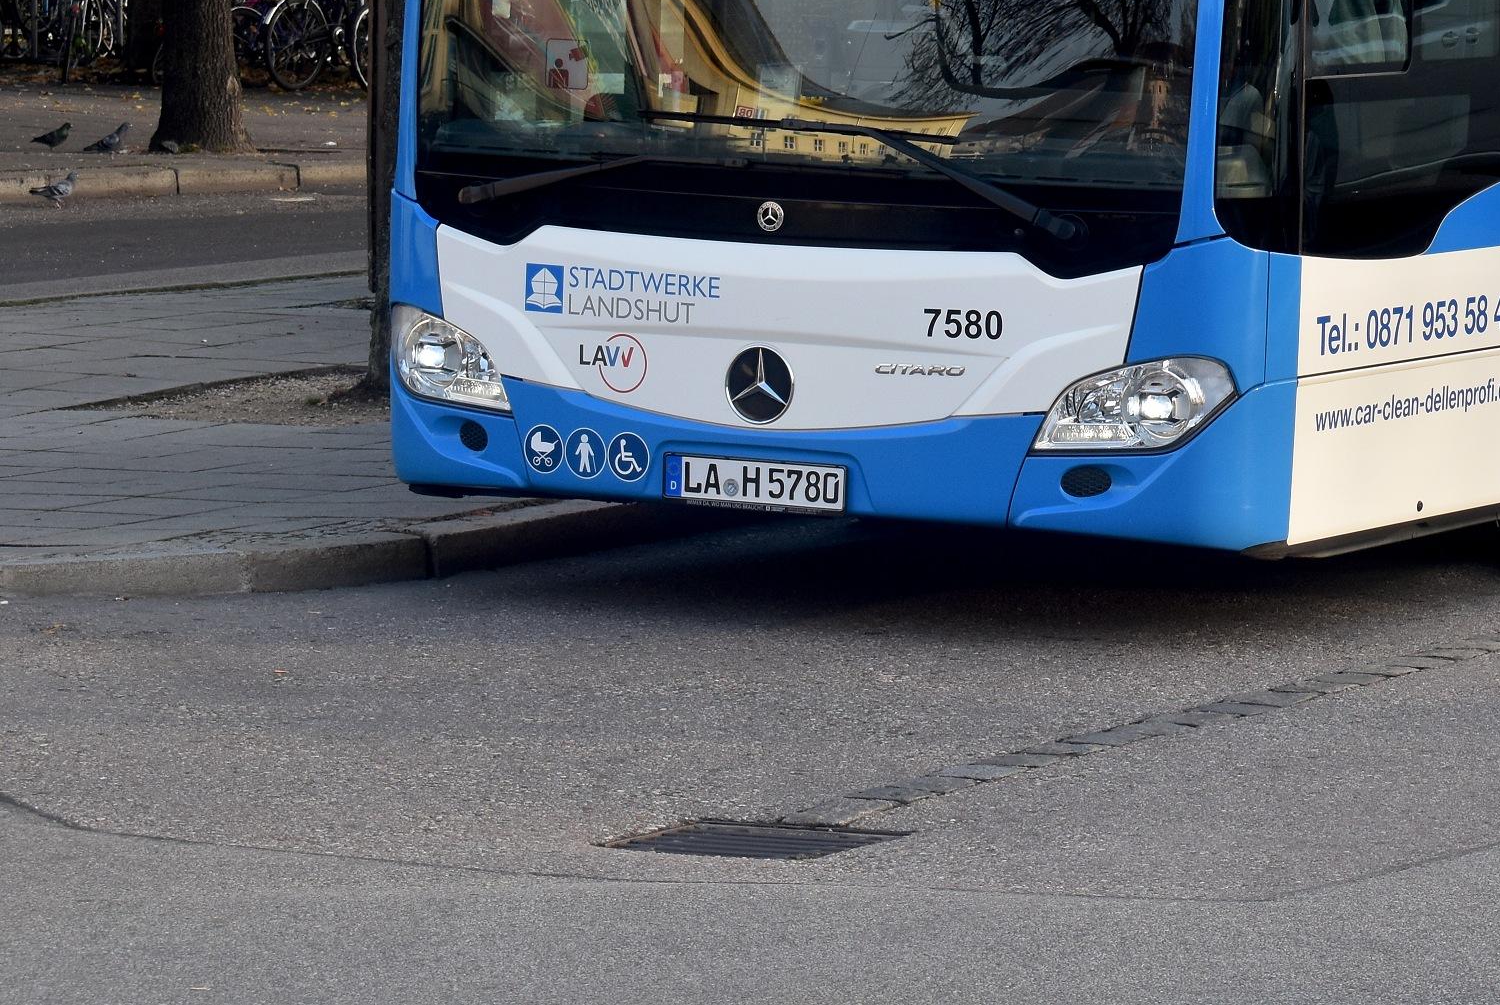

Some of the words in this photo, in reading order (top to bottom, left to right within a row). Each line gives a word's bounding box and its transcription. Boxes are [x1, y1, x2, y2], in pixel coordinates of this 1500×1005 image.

[568, 266, 721, 298] STADTWERKE
[568, 294, 696, 324] LANDSHUT
[923, 308, 1003, 340] 7580
[1316, 313, 1359, 357] Tel.:
[1365, 304, 1414, 350] 0871
[1422, 297, 1458, 342] 953
[1464, 295, 1488, 335] 58
[875, 362, 966, 377] CITARO
[670, 480, 677, 490] D
[684, 461, 721, 495] LA
[742, 465, 761, 498] H
